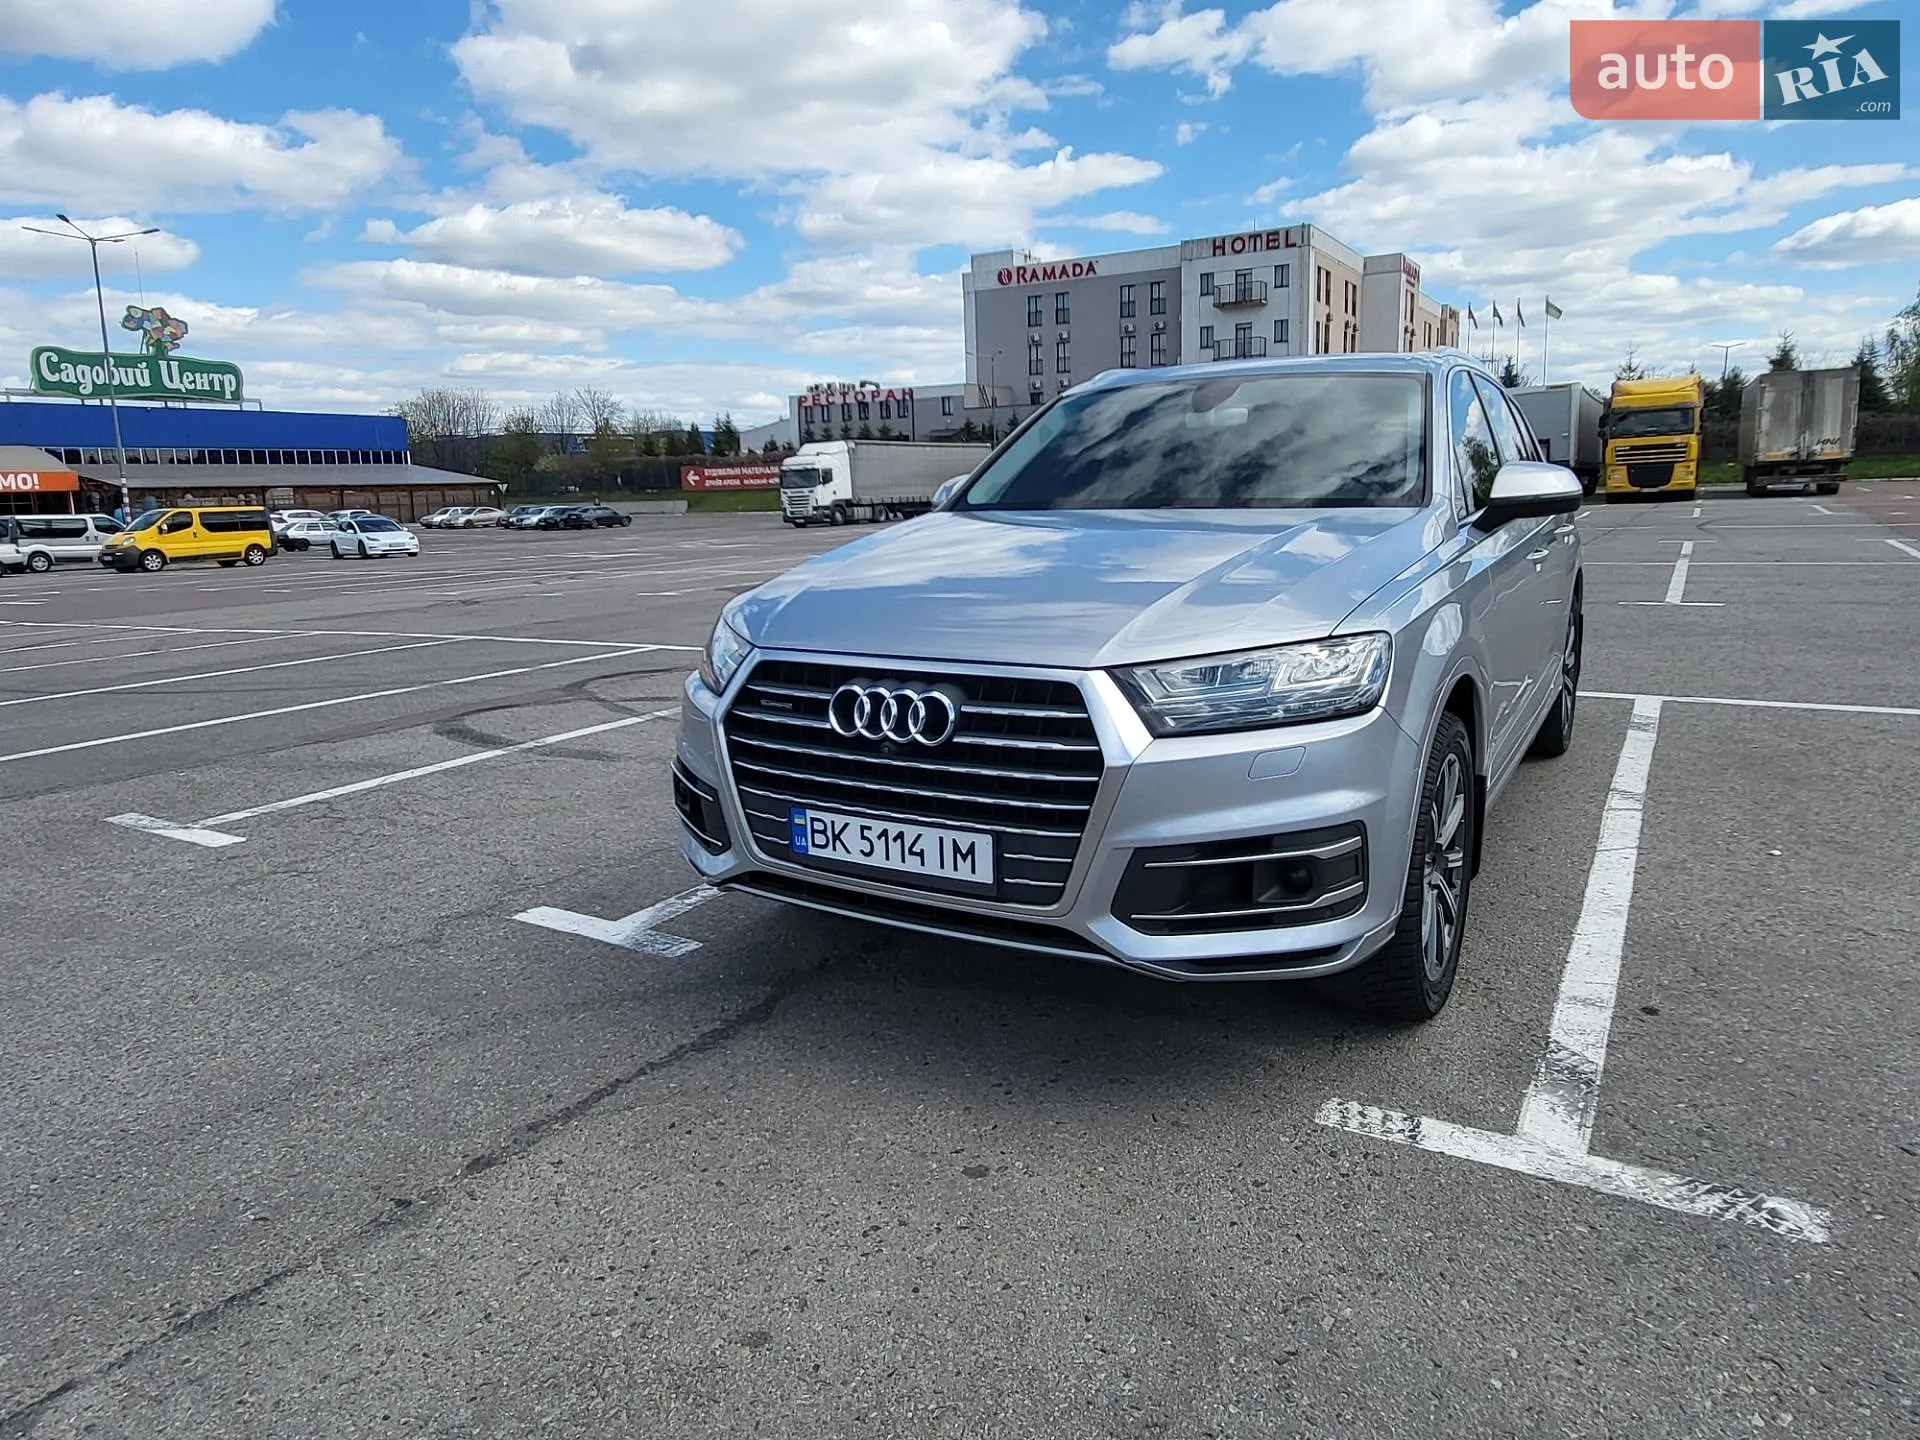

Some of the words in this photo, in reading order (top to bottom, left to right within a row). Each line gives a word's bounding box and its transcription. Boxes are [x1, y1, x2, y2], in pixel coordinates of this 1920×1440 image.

[1212, 229, 1297, 257] HOTEL
[1016, 260, 1097, 284] RAMADA
[39, 351, 152, 395] Садовий
[158, 360, 237, 399] Центр
[797, 387, 914, 408] РЕСТОРАН
[794, 836, 807, 847] UA
[809, 816, 852, 855] BK
[859, 824, 925, 867] 5114
[939, 836, 976, 875] IM
